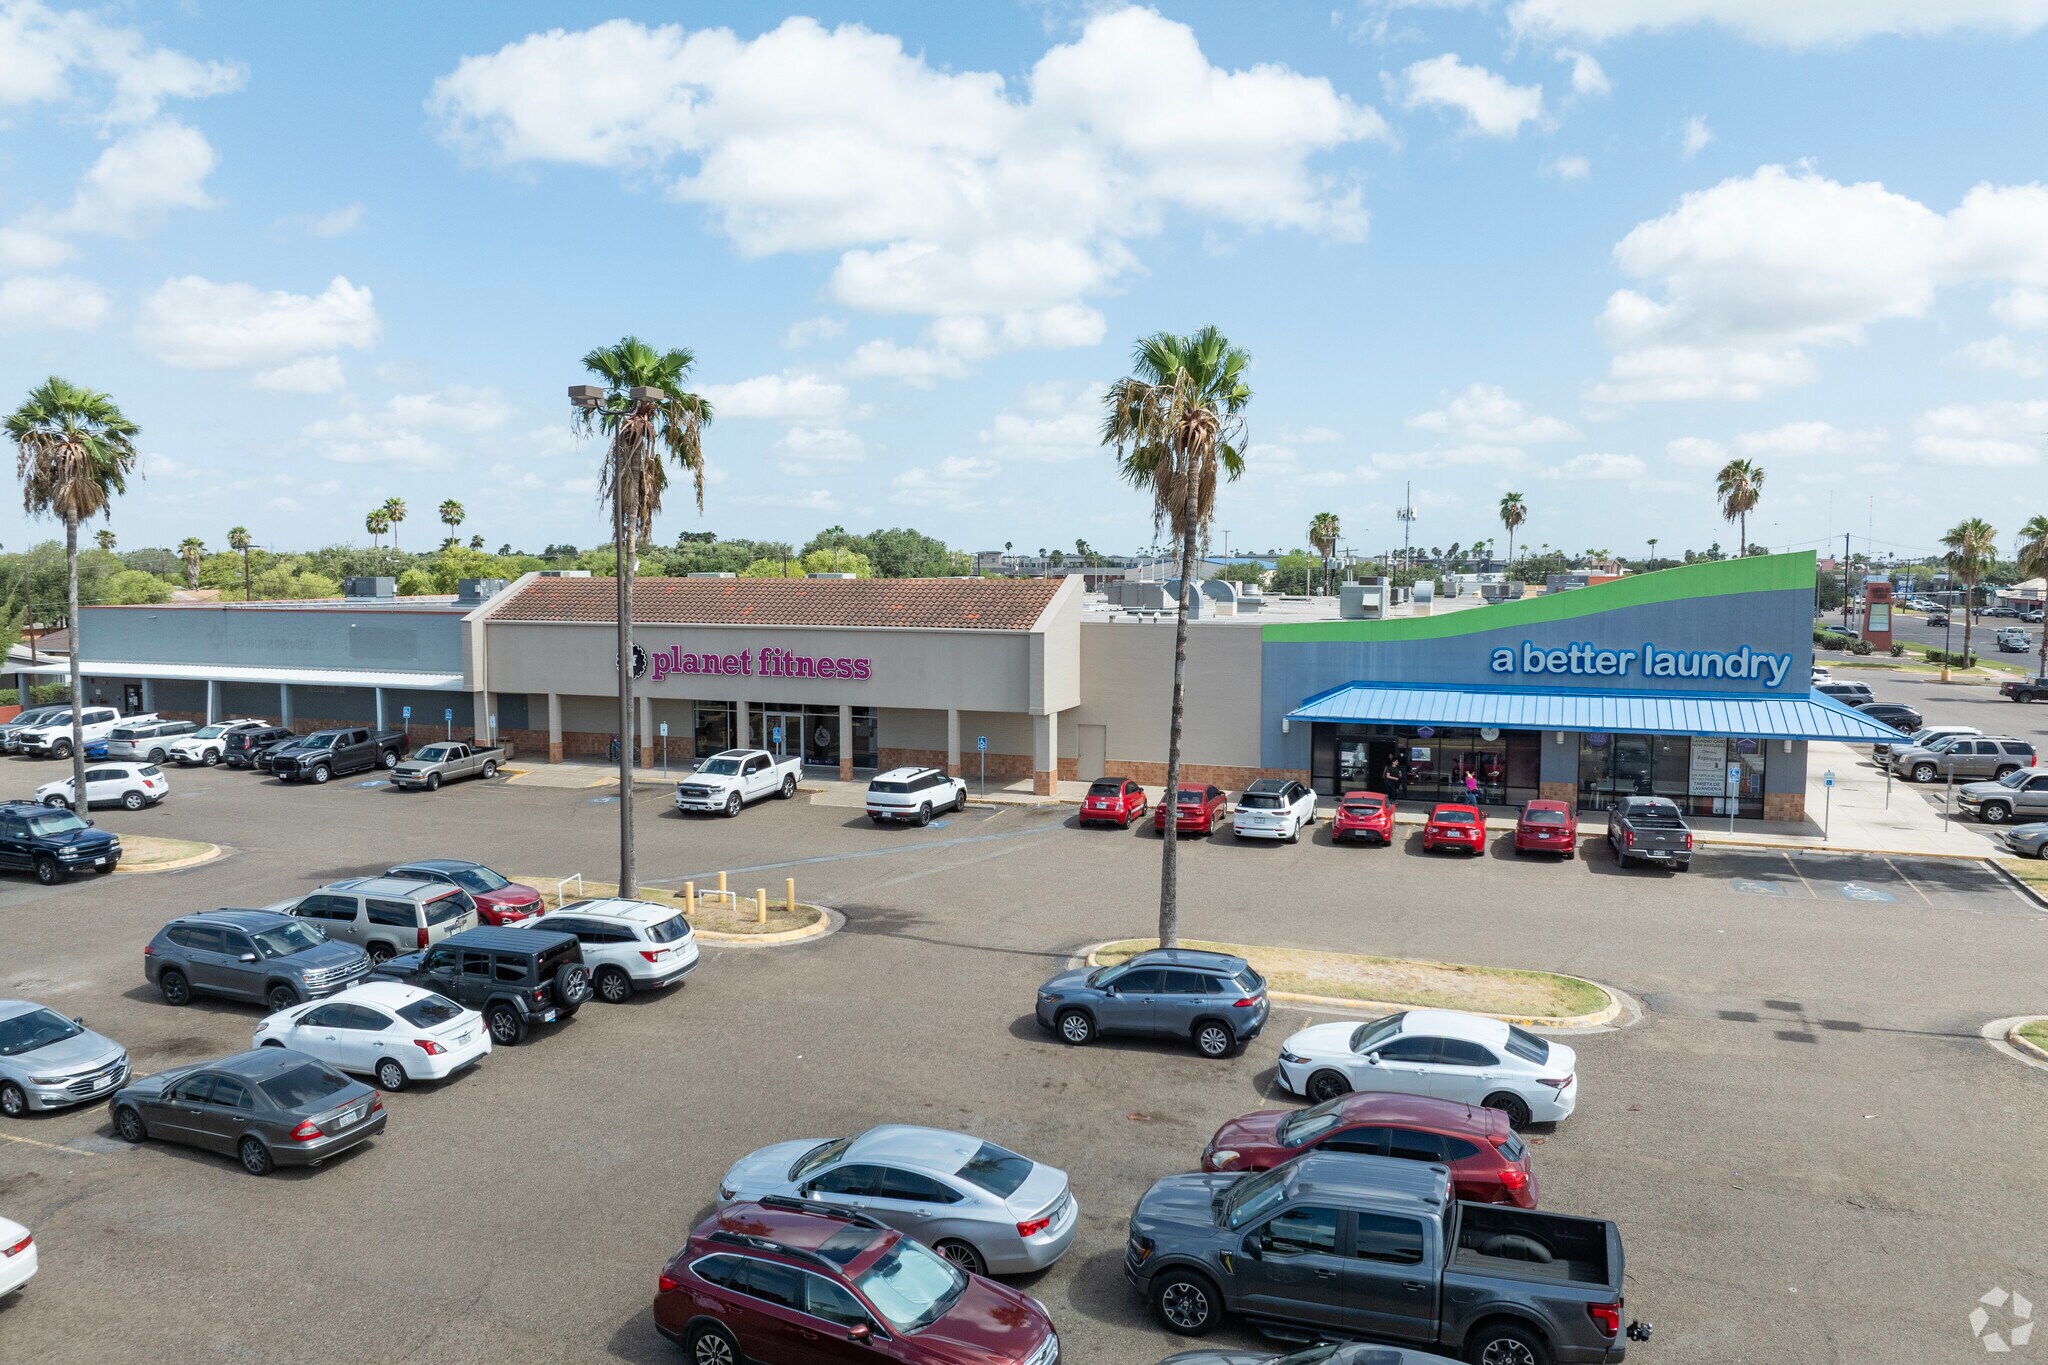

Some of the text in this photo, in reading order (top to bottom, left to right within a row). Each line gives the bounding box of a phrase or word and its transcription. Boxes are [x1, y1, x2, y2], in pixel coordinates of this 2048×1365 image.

[651, 645, 872, 681] planet fitness
[1492, 641, 1792, 688] a better laundry
